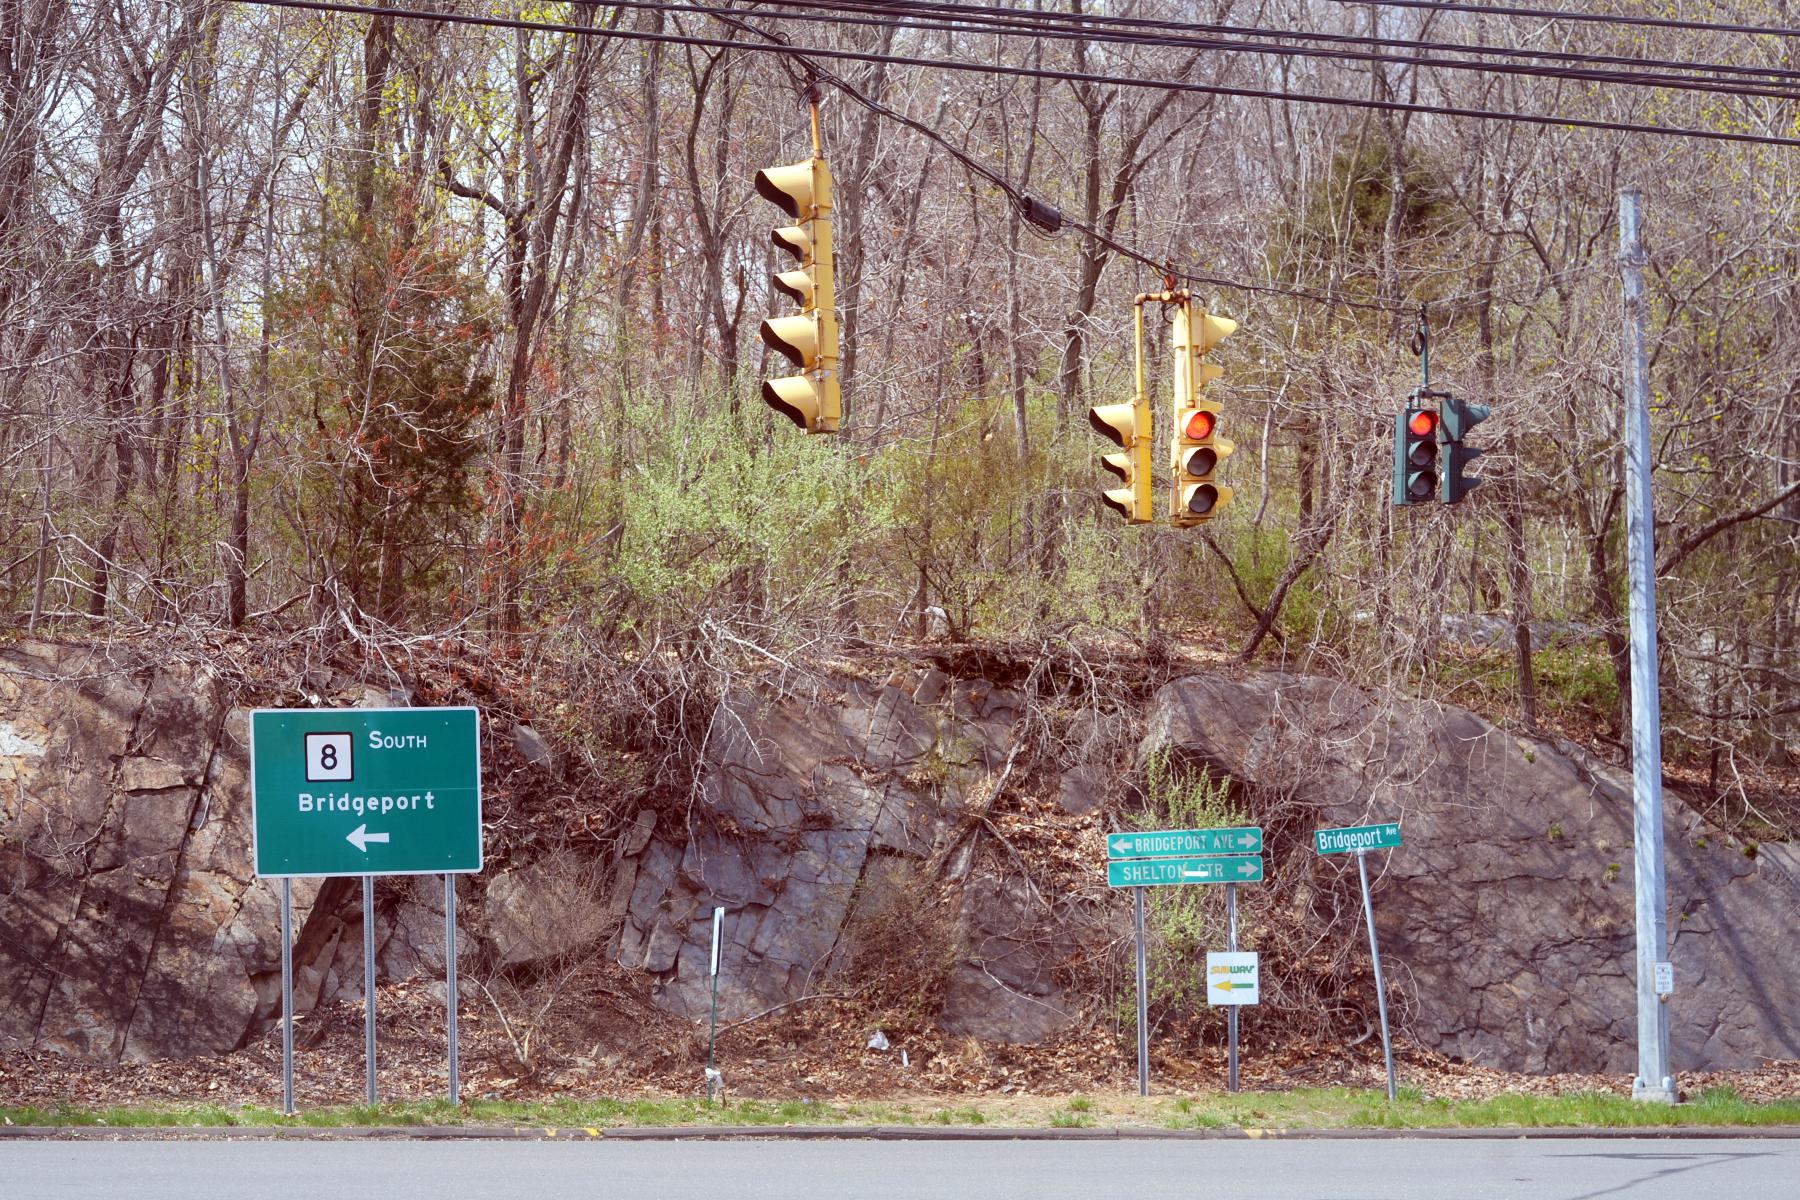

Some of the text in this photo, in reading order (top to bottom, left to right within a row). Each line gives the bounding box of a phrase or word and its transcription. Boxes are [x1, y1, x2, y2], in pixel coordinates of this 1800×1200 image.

[369, 730, 427, 749] SOUTH
[320, 743, 338, 770] 8
[298, 791, 435, 816] Bridgeport
[1135, 834, 1235, 853] BRIDGEPORT AVE
[1318, 826, 1397, 850] Bridgeport Ave
[1123, 864, 1186, 881] SHELTON
[1210, 965, 1255, 975] SUBWAY
